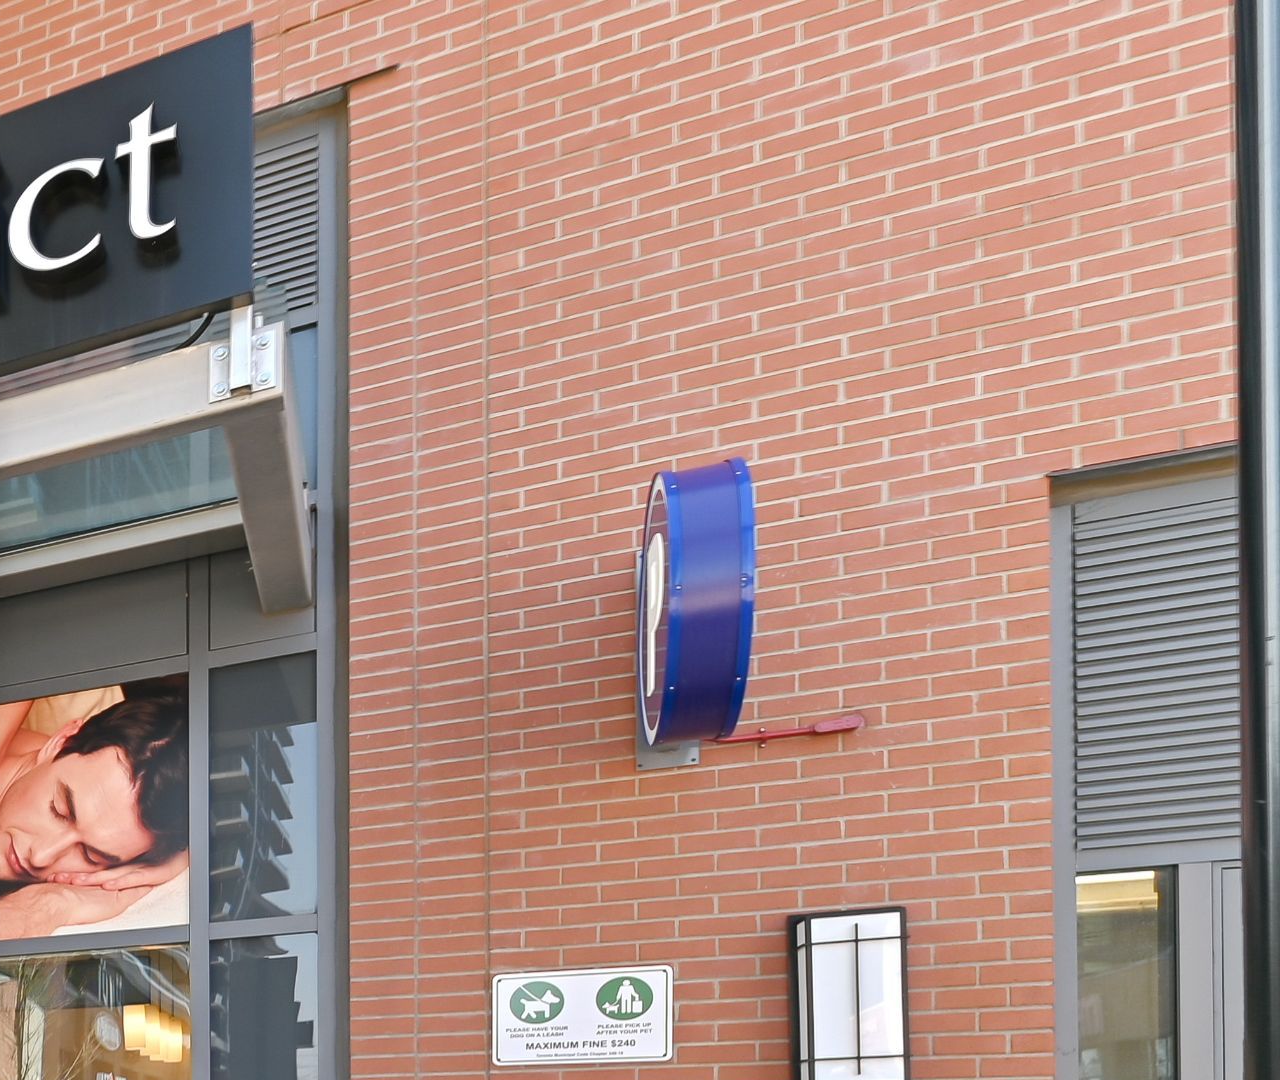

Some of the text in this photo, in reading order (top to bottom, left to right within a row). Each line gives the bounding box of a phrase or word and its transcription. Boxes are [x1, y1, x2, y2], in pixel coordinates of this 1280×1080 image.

[525, 1038, 636, 1050] MAXIMUM FINE $240
